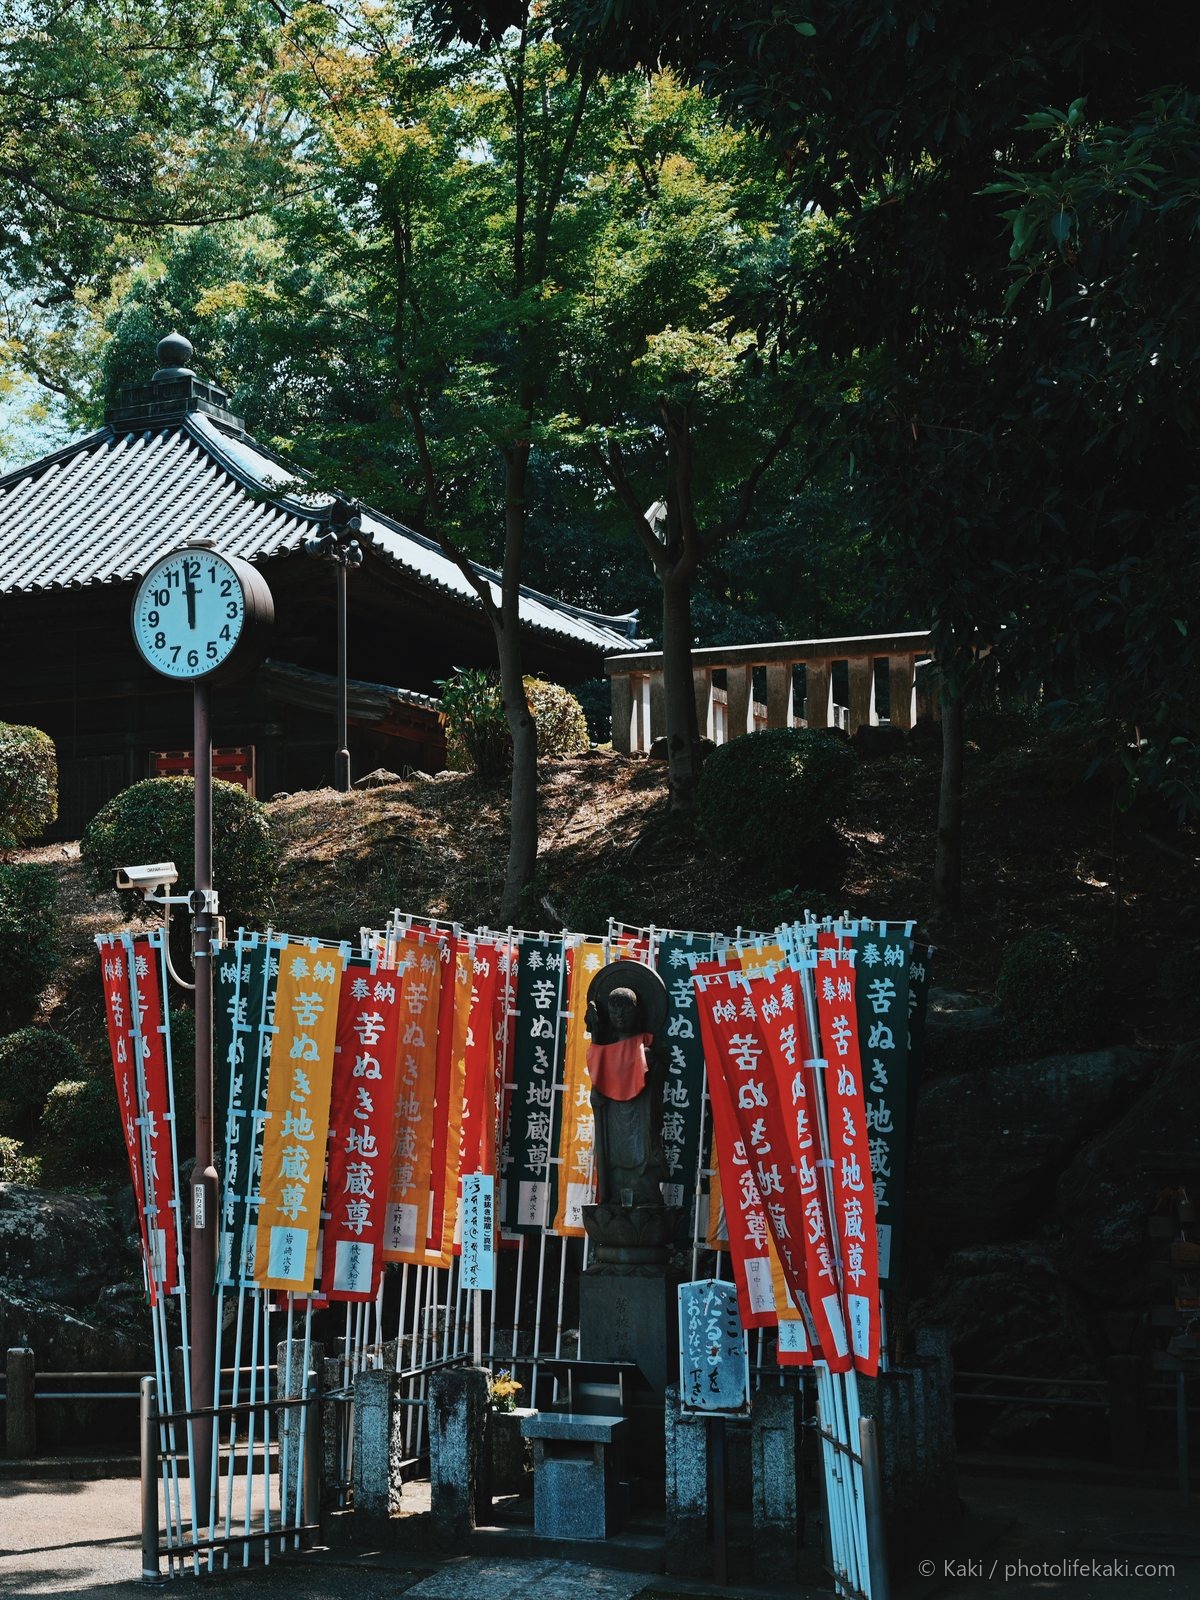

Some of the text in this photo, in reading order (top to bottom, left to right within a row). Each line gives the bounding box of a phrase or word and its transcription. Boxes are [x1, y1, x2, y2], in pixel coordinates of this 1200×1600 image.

[164, 570, 180, 588] 11
[207, 566, 216, 583] 1
[151, 588, 170, 607] 10
[220, 579, 232, 597] 2
[147, 610, 160, 628] 9
[226, 601, 238, 619] 3
[154, 631, 166, 649] 8
[219, 624, 231, 641] 4
[169, 645, 182, 663] 7
[187, 649, 199, 668] 6
[206, 641, 218, 659] 5
[403, 949, 437, 976] 奉納
[526, 950, 562, 972] 奉納
[861, 942, 904, 968] 奉納
[288, 956, 336, 985] 奉納
[349, 977, 396, 1005] 奉納
[822, 975, 852, 1005] 奉納
[391, 982, 429, 1197] 苦ぬき地蔵尊
[524, 979, 557, 1176] 苦ぬき地蔵尊
[660, 978, 696, 1177] 苦ぬき地蔵尊
[276, 991, 325, 1222] 苦ぬき地蔵尊
[865, 978, 897, 1215] 苦ぬき地蔵尊
[340, 1011, 386, 1236] 苦ぬき地蔵尊
[830, 1014, 867, 1288] 苦ぬき地蔵尊
[703, 1290, 727, 1393] だるまを
